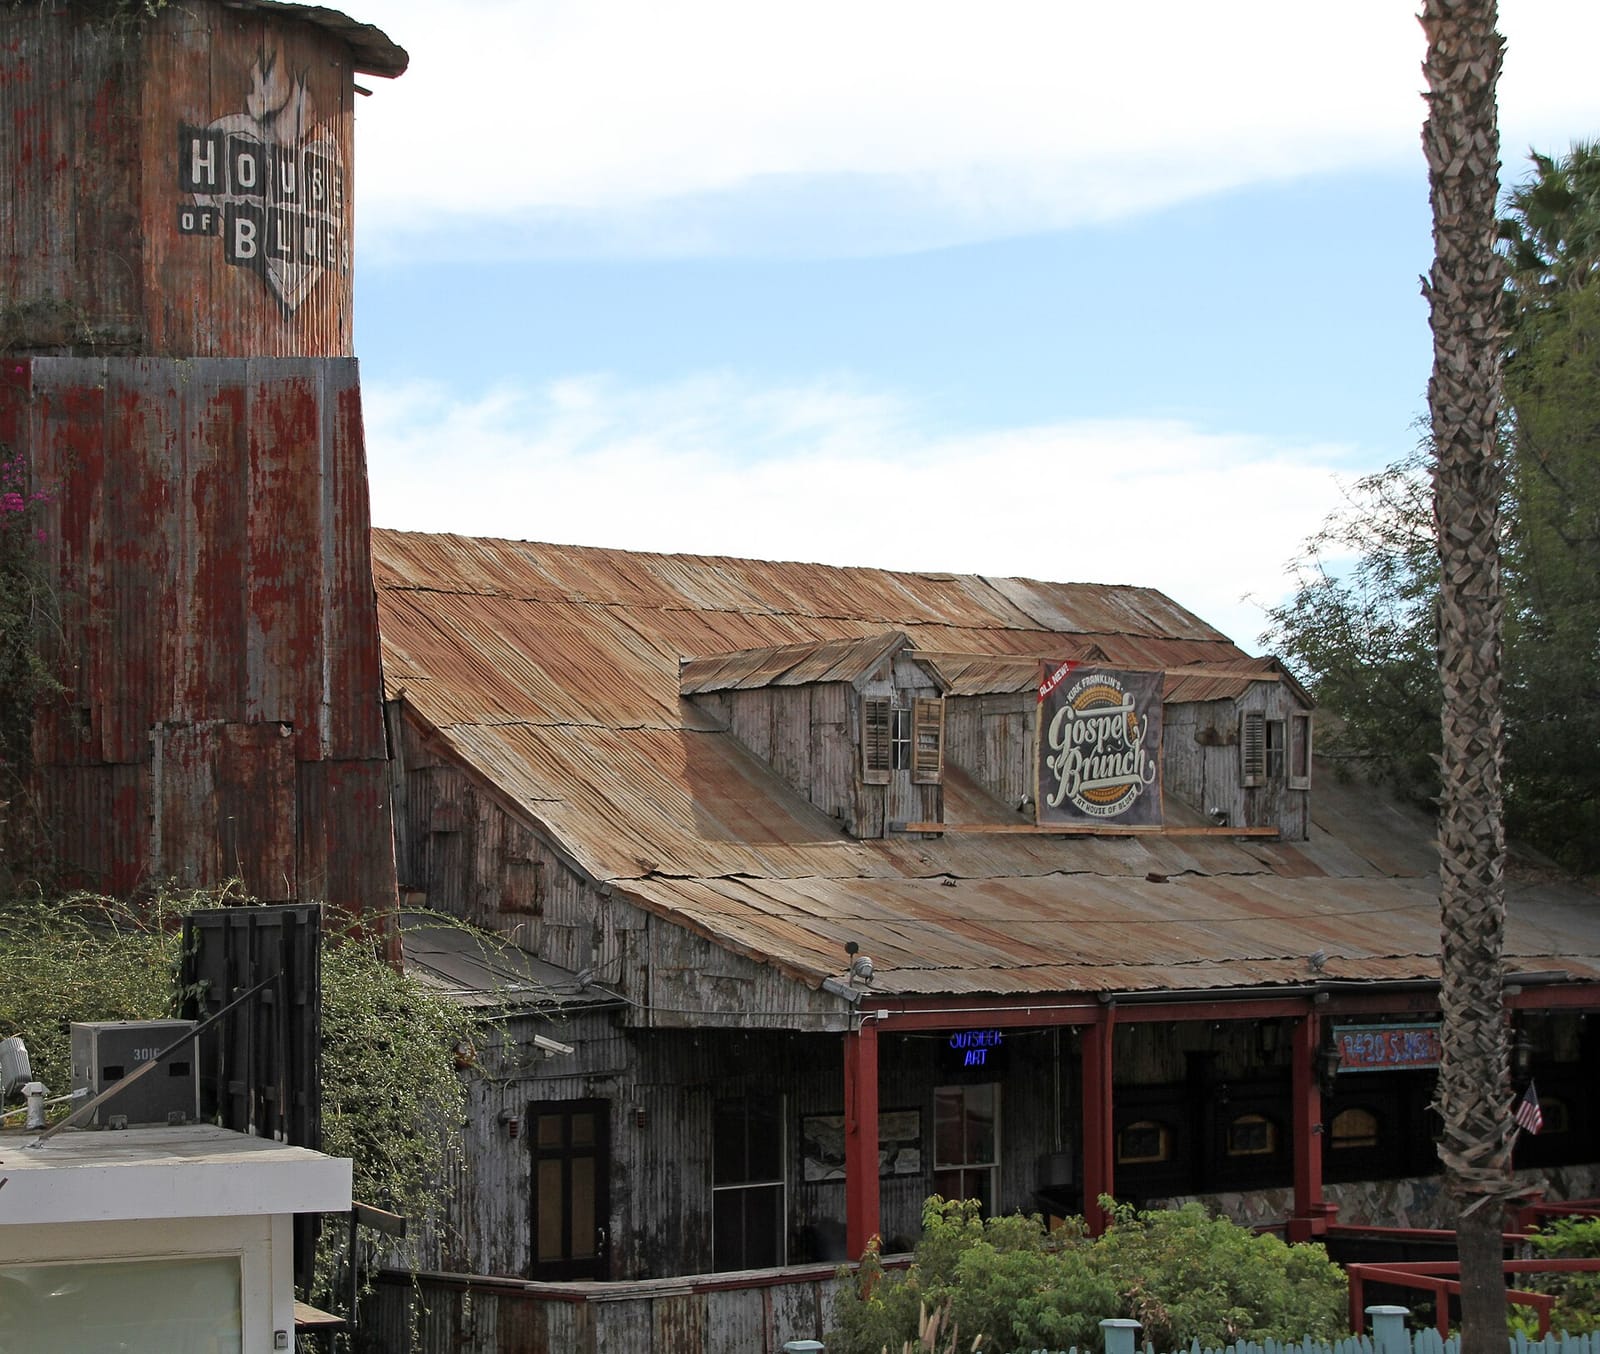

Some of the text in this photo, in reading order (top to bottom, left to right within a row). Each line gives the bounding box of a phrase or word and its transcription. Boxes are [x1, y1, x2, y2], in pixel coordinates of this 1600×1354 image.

[191, 138, 343, 209] HOUSE
[181, 212, 349, 270] OF BLUES
[1039, 680, 1054, 697] ALL
[1066, 673, 1121, 702] KIRK FRANKLIN'S
[1048, 692, 1148, 769] Gospel
[1046, 726, 1156, 808] Brunch
[1076, 798, 1086, 808] AT
[1085, 804, 1106, 815] HOUSE
[1107, 805, 1117, 814] OF
[964, 1048, 989, 1067] ART
